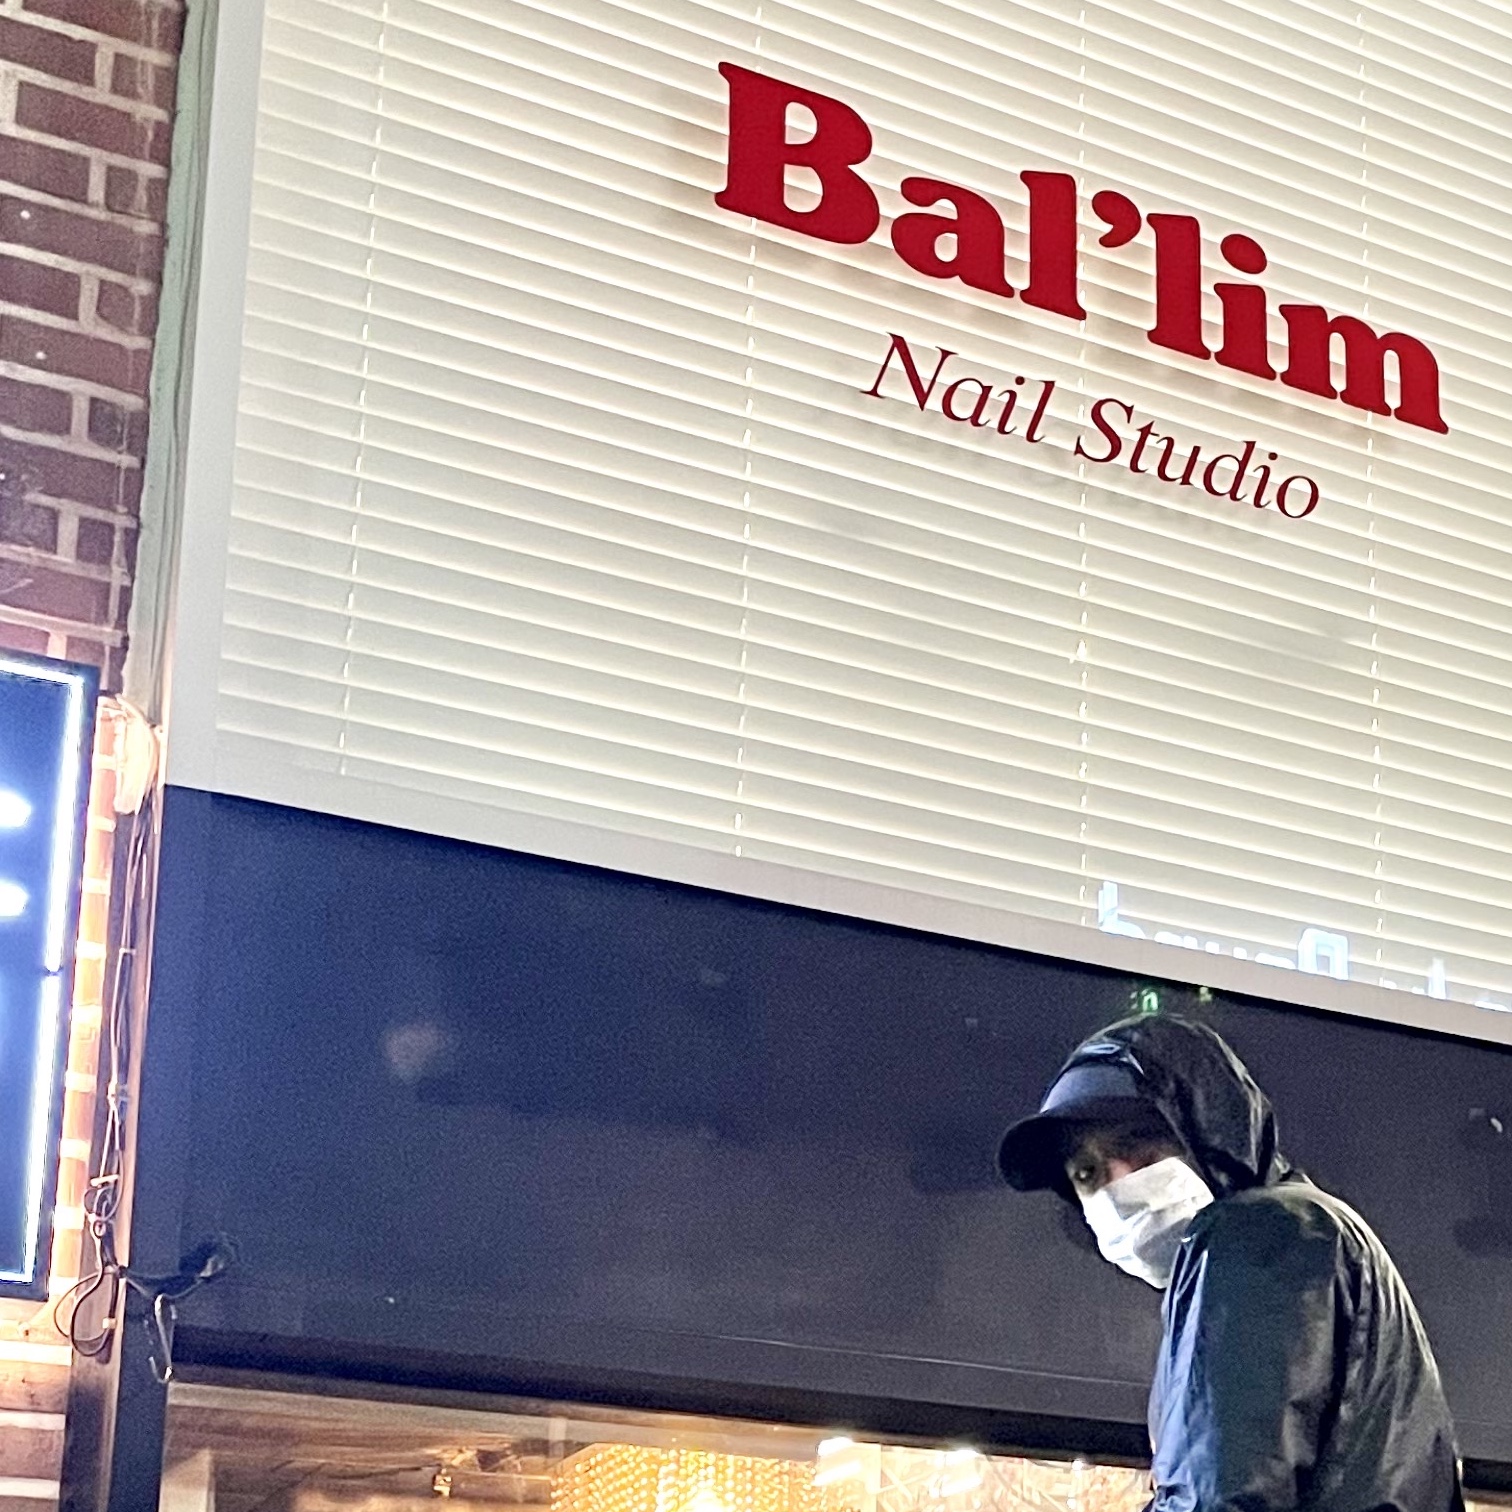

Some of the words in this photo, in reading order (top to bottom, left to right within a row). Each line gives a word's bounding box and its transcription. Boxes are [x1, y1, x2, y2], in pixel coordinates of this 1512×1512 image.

[714, 61, 1449, 434] Bal'lim
[860, 332, 1055, 444] Nail
[1073, 397, 1320, 520] Studio
